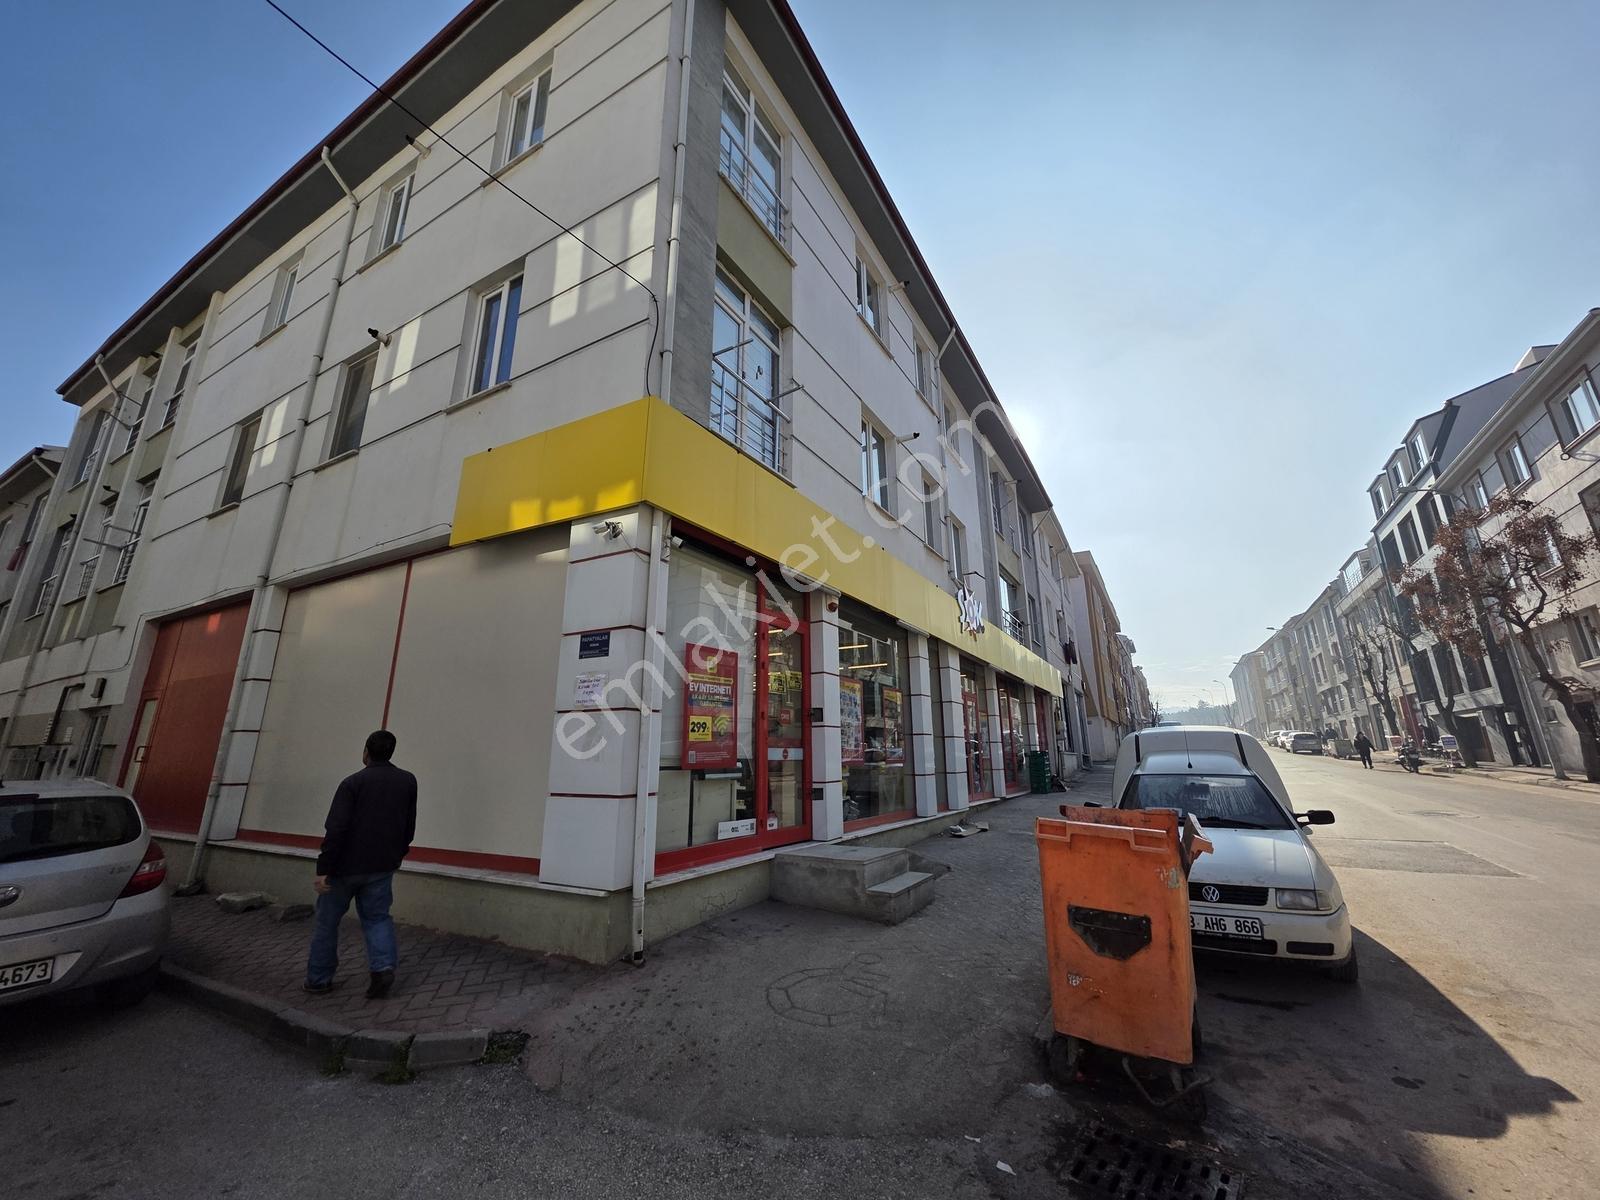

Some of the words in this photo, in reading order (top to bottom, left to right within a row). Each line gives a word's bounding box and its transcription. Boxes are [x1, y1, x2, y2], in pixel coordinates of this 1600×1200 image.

[689, 682, 699, 692] EV
[690, 721, 707, 733] 299
[1204, 916, 1227, 932] AHG
[1234, 919, 1260, 935] 866
[0, 962, 49, 987] 4673
